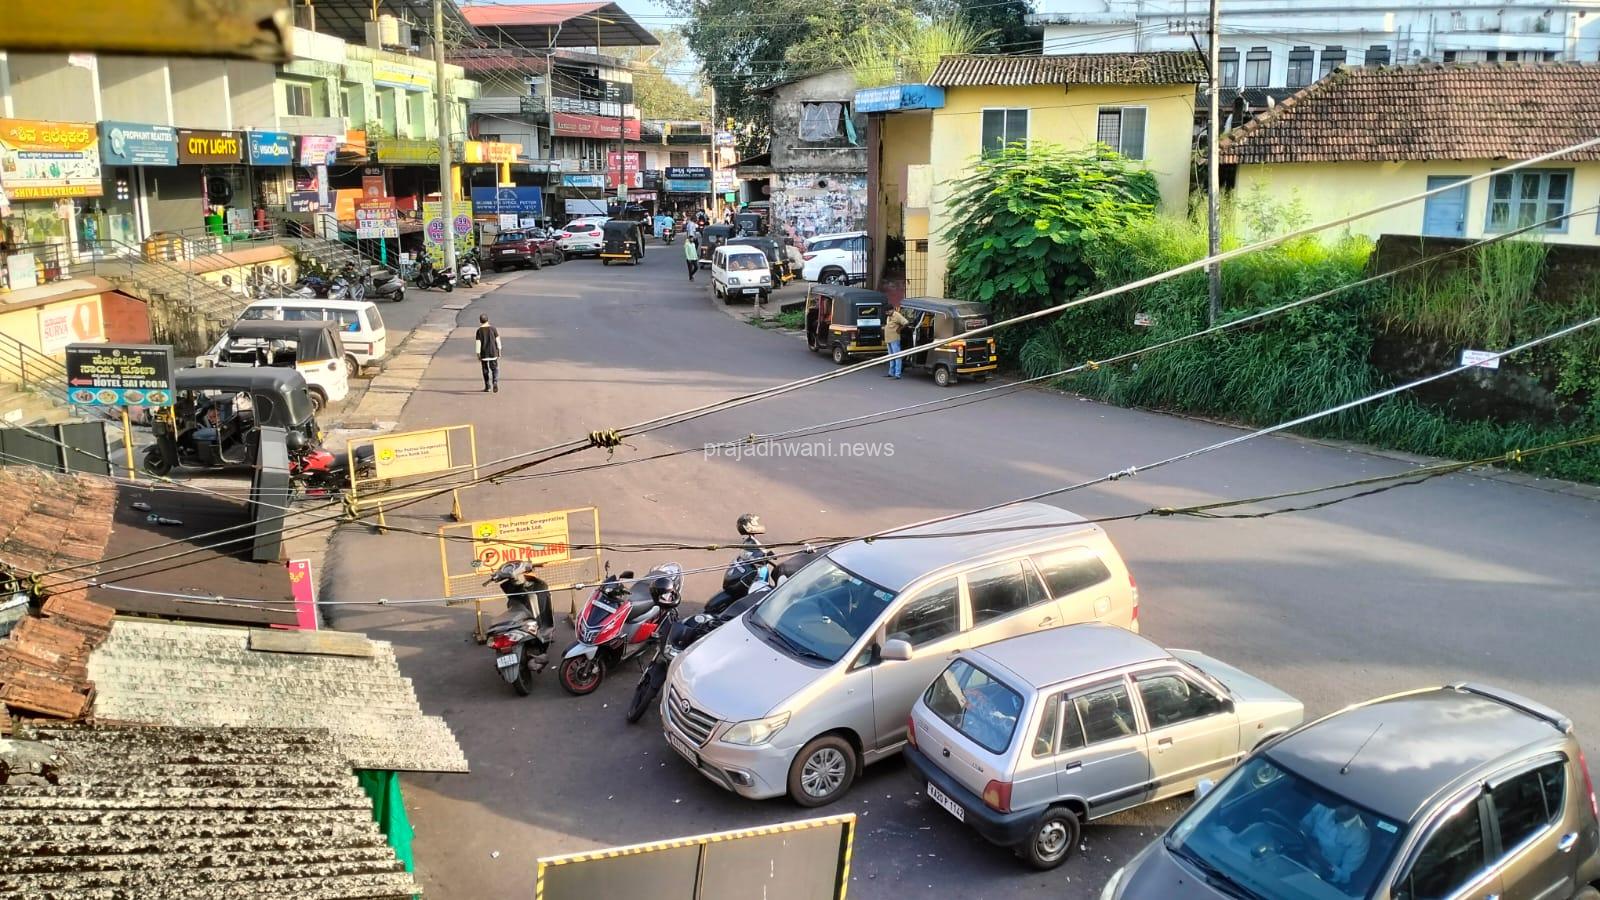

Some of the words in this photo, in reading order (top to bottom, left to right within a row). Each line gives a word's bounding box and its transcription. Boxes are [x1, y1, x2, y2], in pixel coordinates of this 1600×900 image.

[188, 137, 208, 155] CITY
[209, 138, 237, 155] LIGHTS
[15, 188, 39, 198] SHIVA
[42, 186, 86, 197] ELECTRICALS
[93, 379, 121, 387] HOTEL
[122, 380, 137, 388] SAI
[139, 380, 167, 388] POOJA
[510, 520, 529, 528] Puttur
[530, 515, 565, 525] Co-operative
[502, 549, 517, 561] NO
